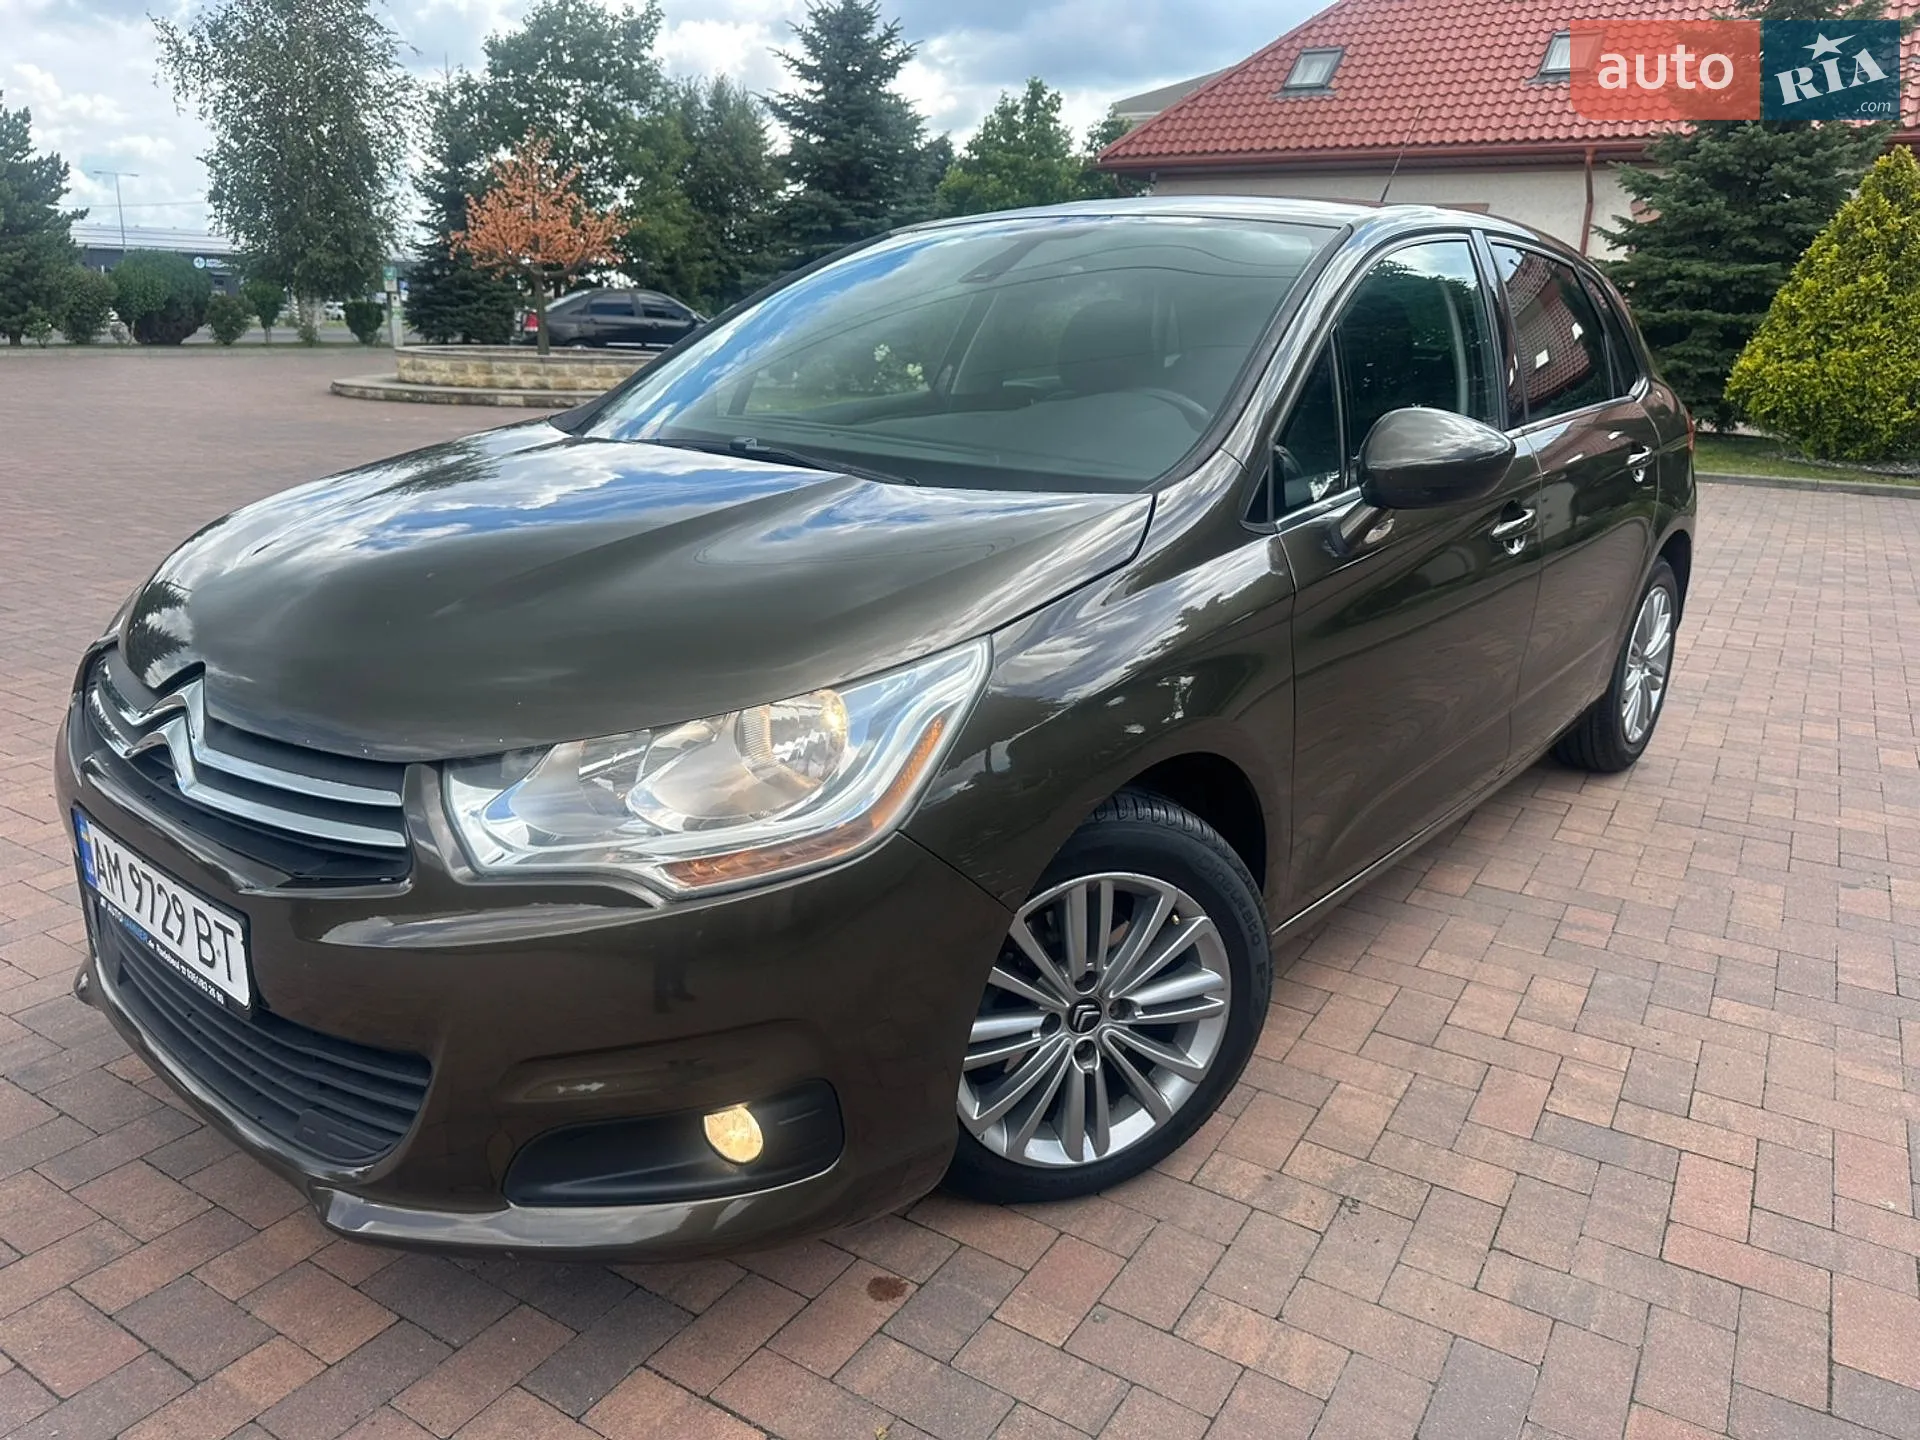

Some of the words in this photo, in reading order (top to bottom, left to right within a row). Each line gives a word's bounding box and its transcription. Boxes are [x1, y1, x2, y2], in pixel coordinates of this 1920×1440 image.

[94, 838, 126, 904] AM
[128, 862, 186, 946] 9729
[193, 907, 235, 982] BT
